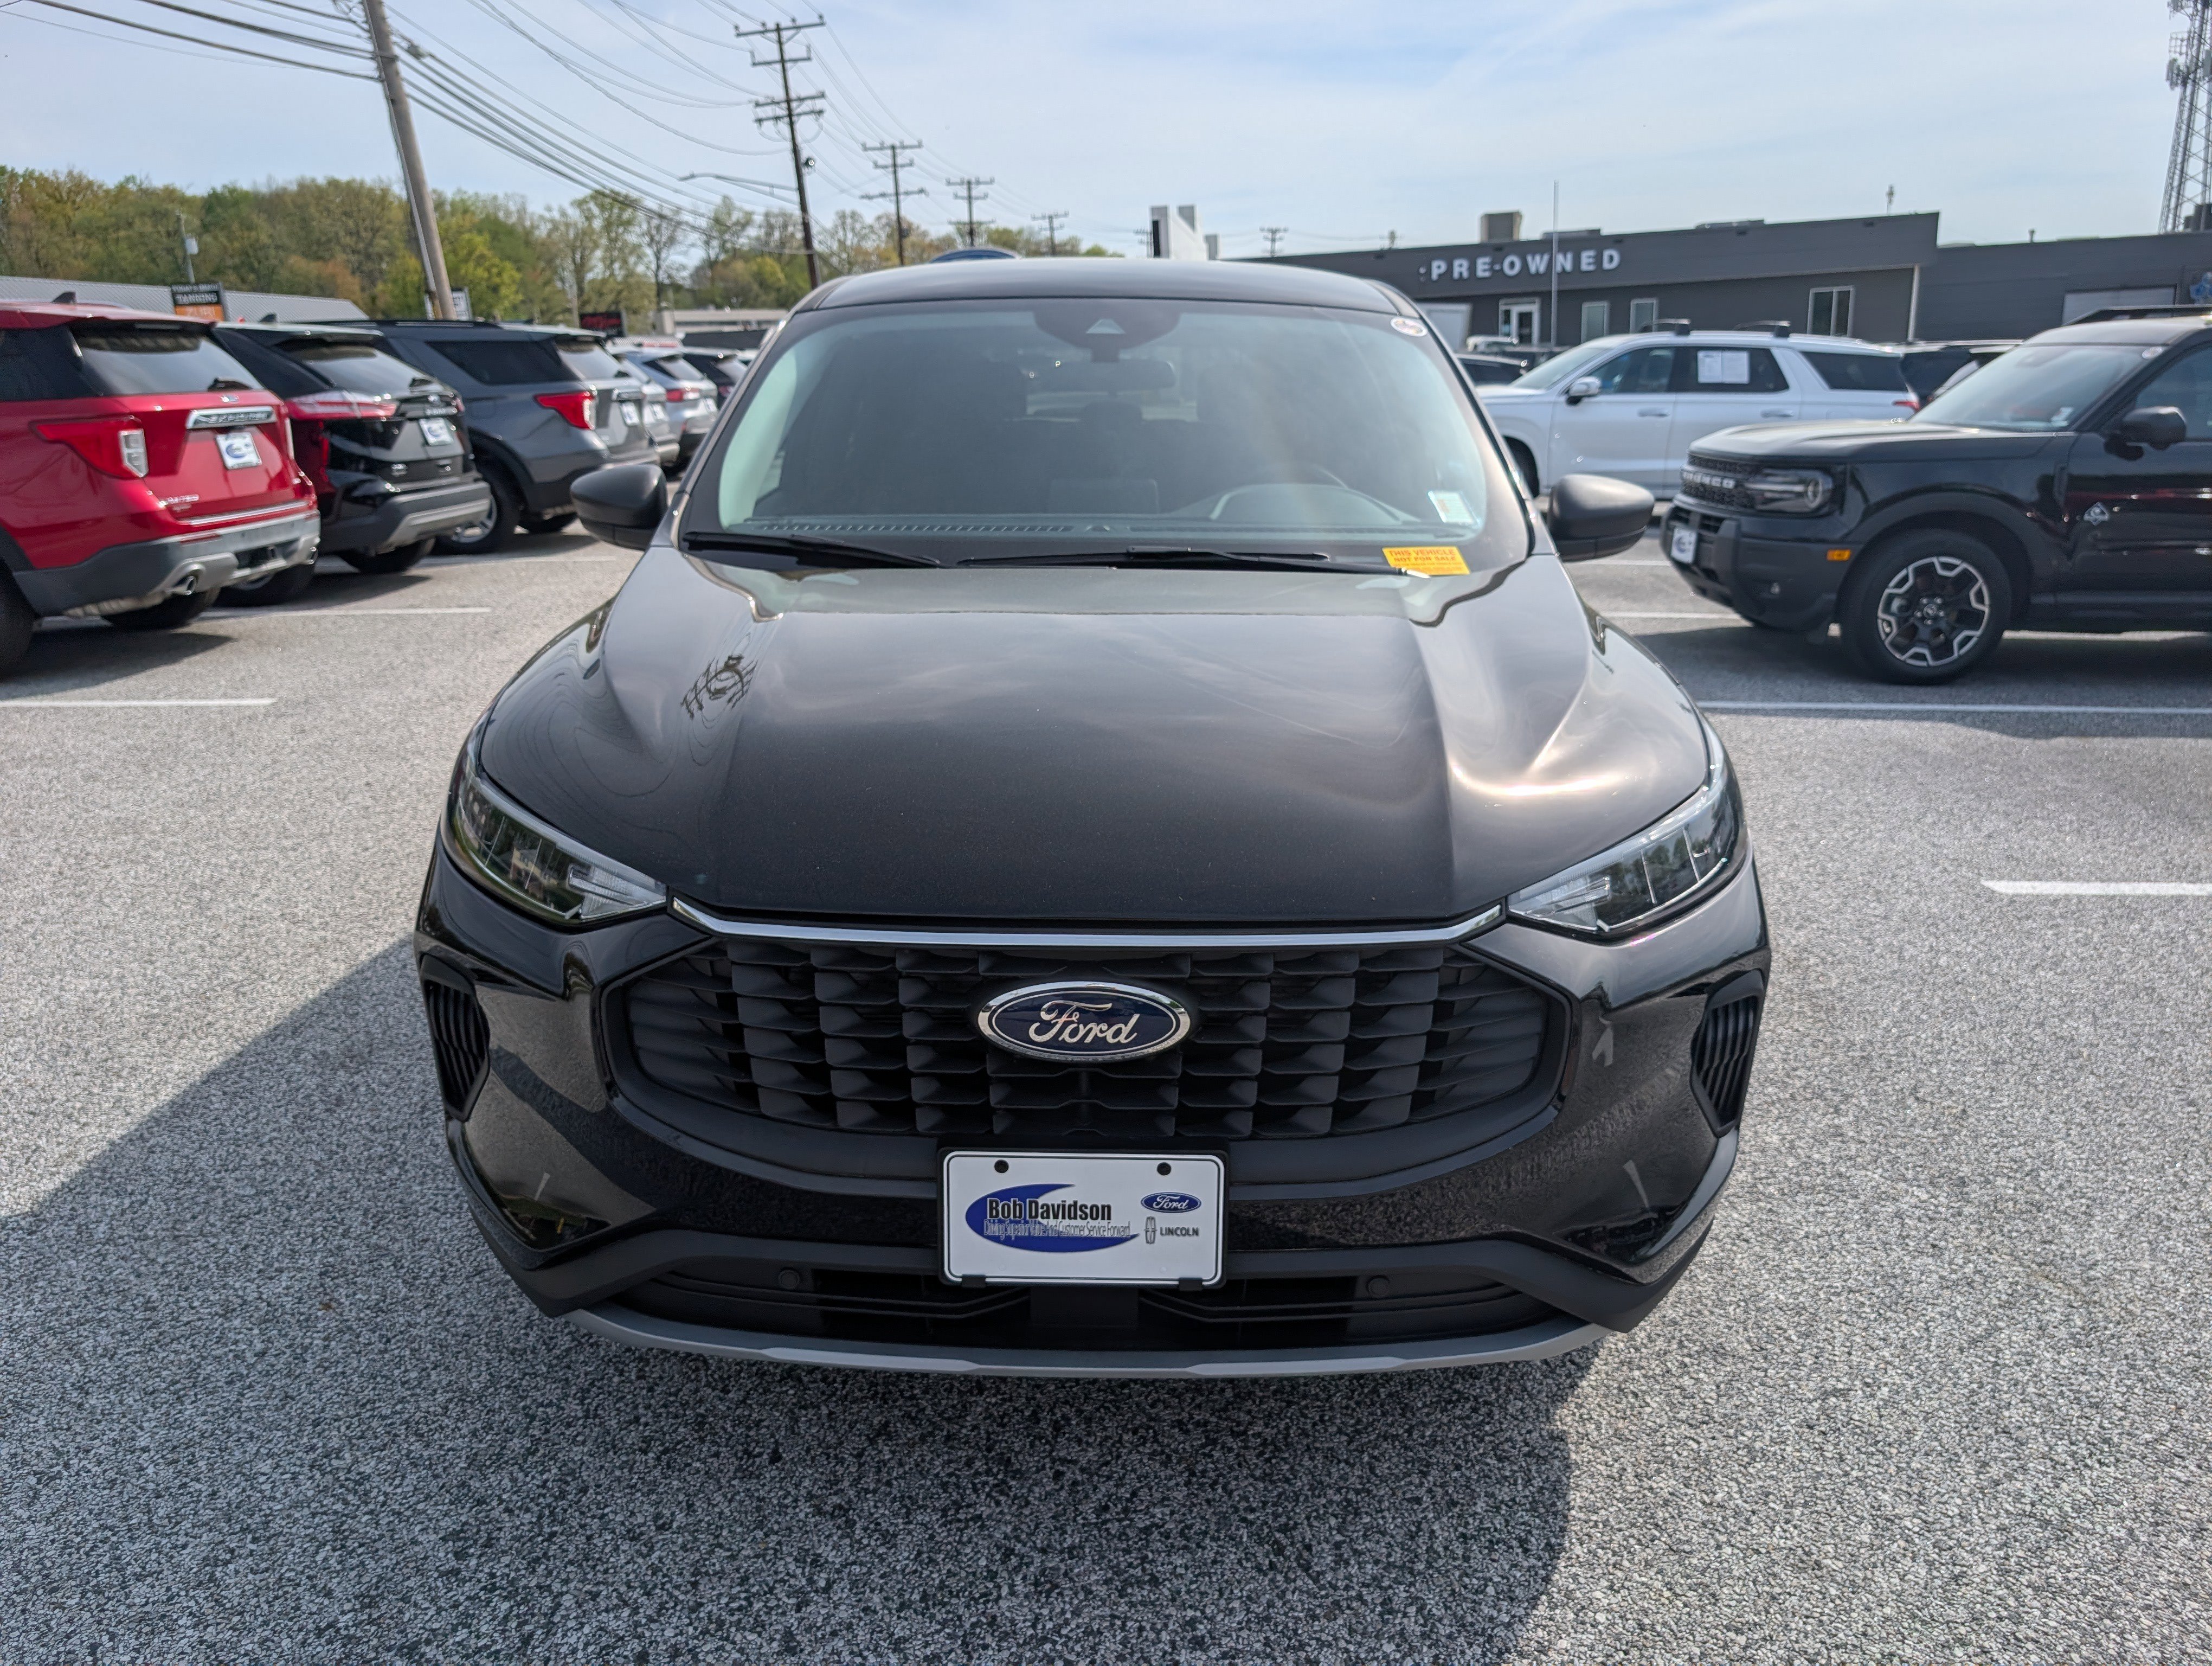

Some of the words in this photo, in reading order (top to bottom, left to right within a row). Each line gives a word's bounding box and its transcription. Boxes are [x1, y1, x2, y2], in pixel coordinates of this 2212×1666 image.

[1431, 248, 1621, 281] PRE-OWNED
[175, 293, 217, 304] TANNING
[1028, 1000, 1140, 1043] Ford
[987, 1198, 1024, 1220] Bob
[1026, 1198, 1111, 1221] Davidson
[1153, 1195, 1189, 1209] Ford
[1160, 1226, 1199, 1236] LINCOLN
